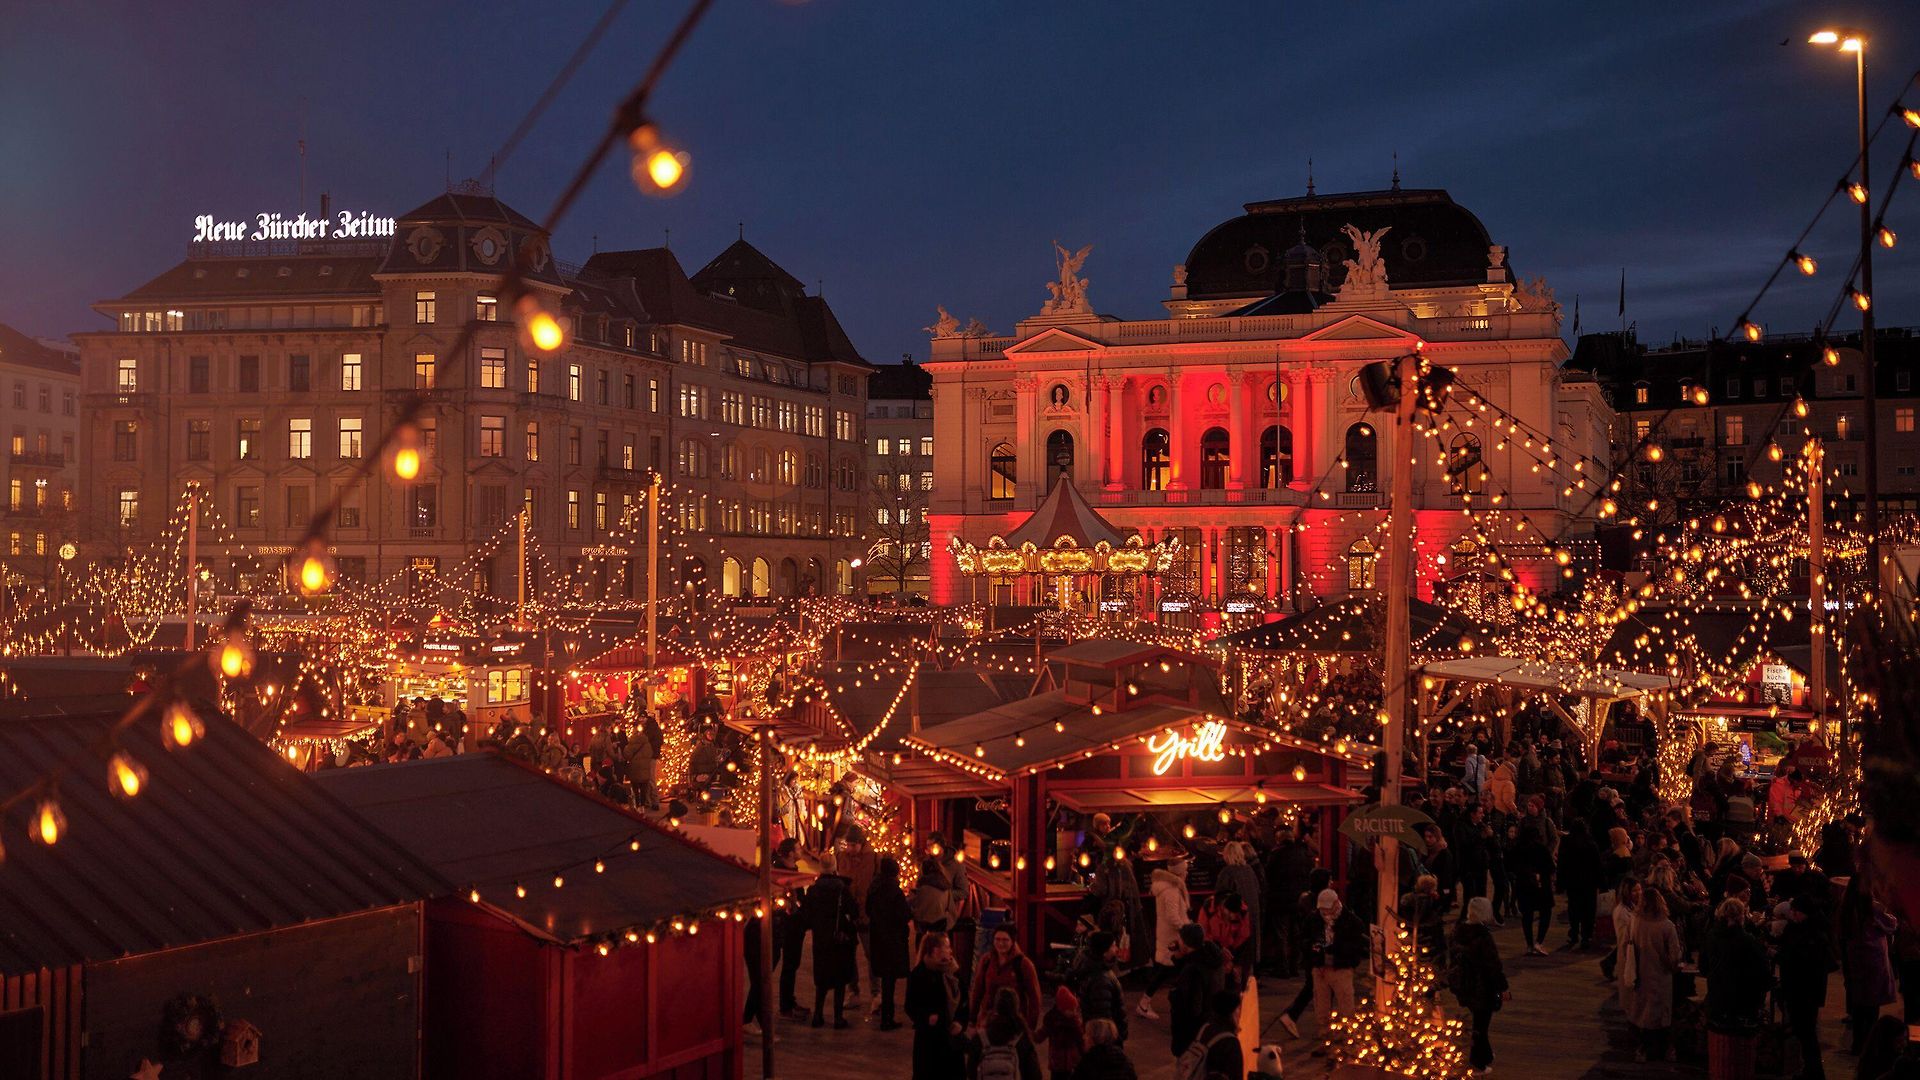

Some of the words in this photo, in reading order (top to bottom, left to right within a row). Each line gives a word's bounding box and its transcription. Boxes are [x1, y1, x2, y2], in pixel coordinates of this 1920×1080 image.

[193, 214, 247, 242] Neue
[251, 212, 329, 241] Zürcher
[257, 546, 298, 555] BRASSER
[1353, 817, 1405, 833] RACLETTE
